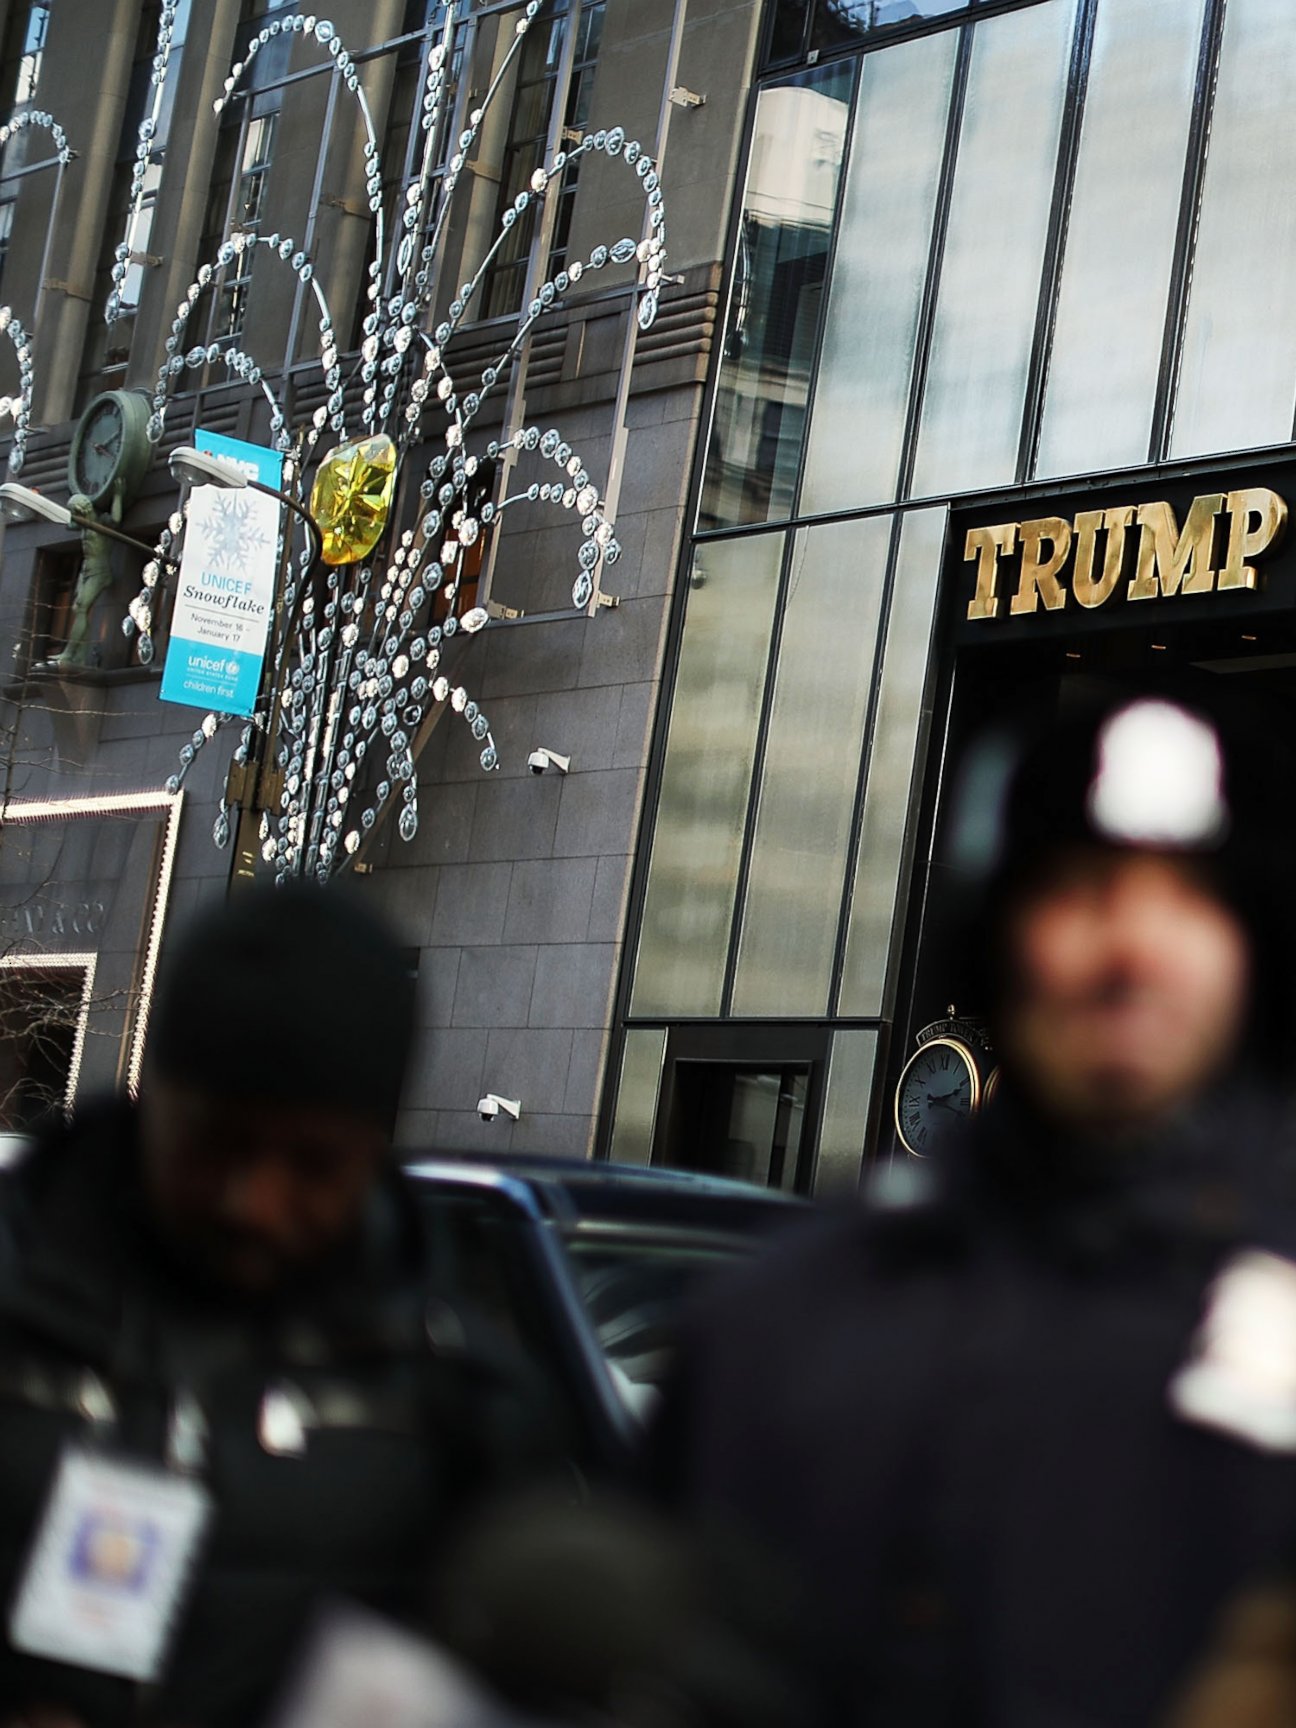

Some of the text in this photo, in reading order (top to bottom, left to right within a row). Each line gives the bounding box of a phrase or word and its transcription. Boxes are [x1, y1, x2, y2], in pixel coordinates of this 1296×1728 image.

[964, 487, 1288, 621] TRUMP
[201, 572, 252, 595] UNICEF
[183, 585, 264, 615] Snowflake
[191, 613, 233, 629] November
[197, 627, 241, 642] January 17
[188, 655, 226, 672] unicef
[183, 680, 216, 694] children
